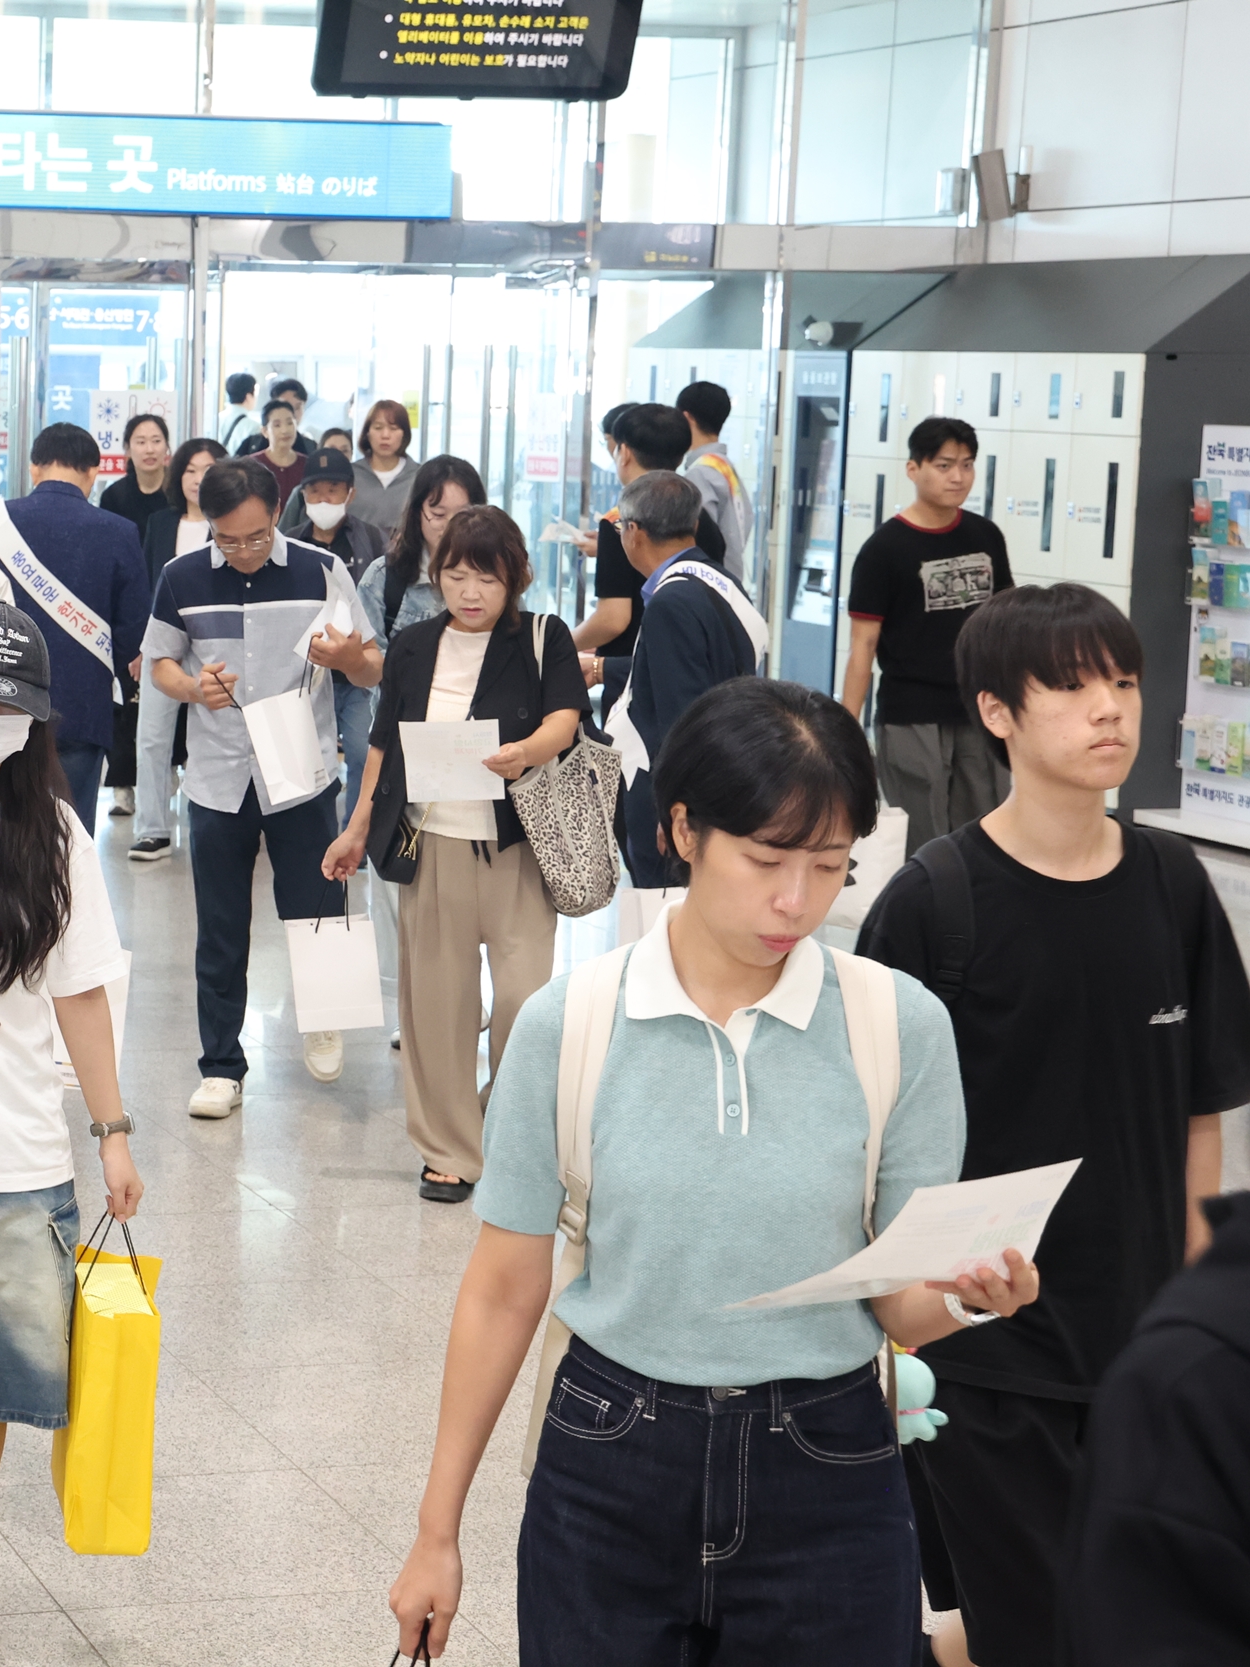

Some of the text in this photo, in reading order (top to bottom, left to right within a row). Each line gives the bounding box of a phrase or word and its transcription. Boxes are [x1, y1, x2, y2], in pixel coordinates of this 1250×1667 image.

[399, 13, 421, 27] 대형
[499, 15, 531, 28] 손수레
[533, 16, 555, 28] 소지
[397, 30, 584, 47] 엘리베이터를 이용하여 주시기 바랍니다
[393, 52, 569, 68] 노약자나 어린이는 보호가 필요합니다
[107, 134, 158, 193] 곳
[167, 167, 267, 193] Platforms
[276, 172, 315, 196] 站台
[321, 175, 378, 197] のりば
[51, 385, 73, 411] 곳
[11, 550, 60, 603] 풍요로운
[57, 600, 98, 637] 한가위
